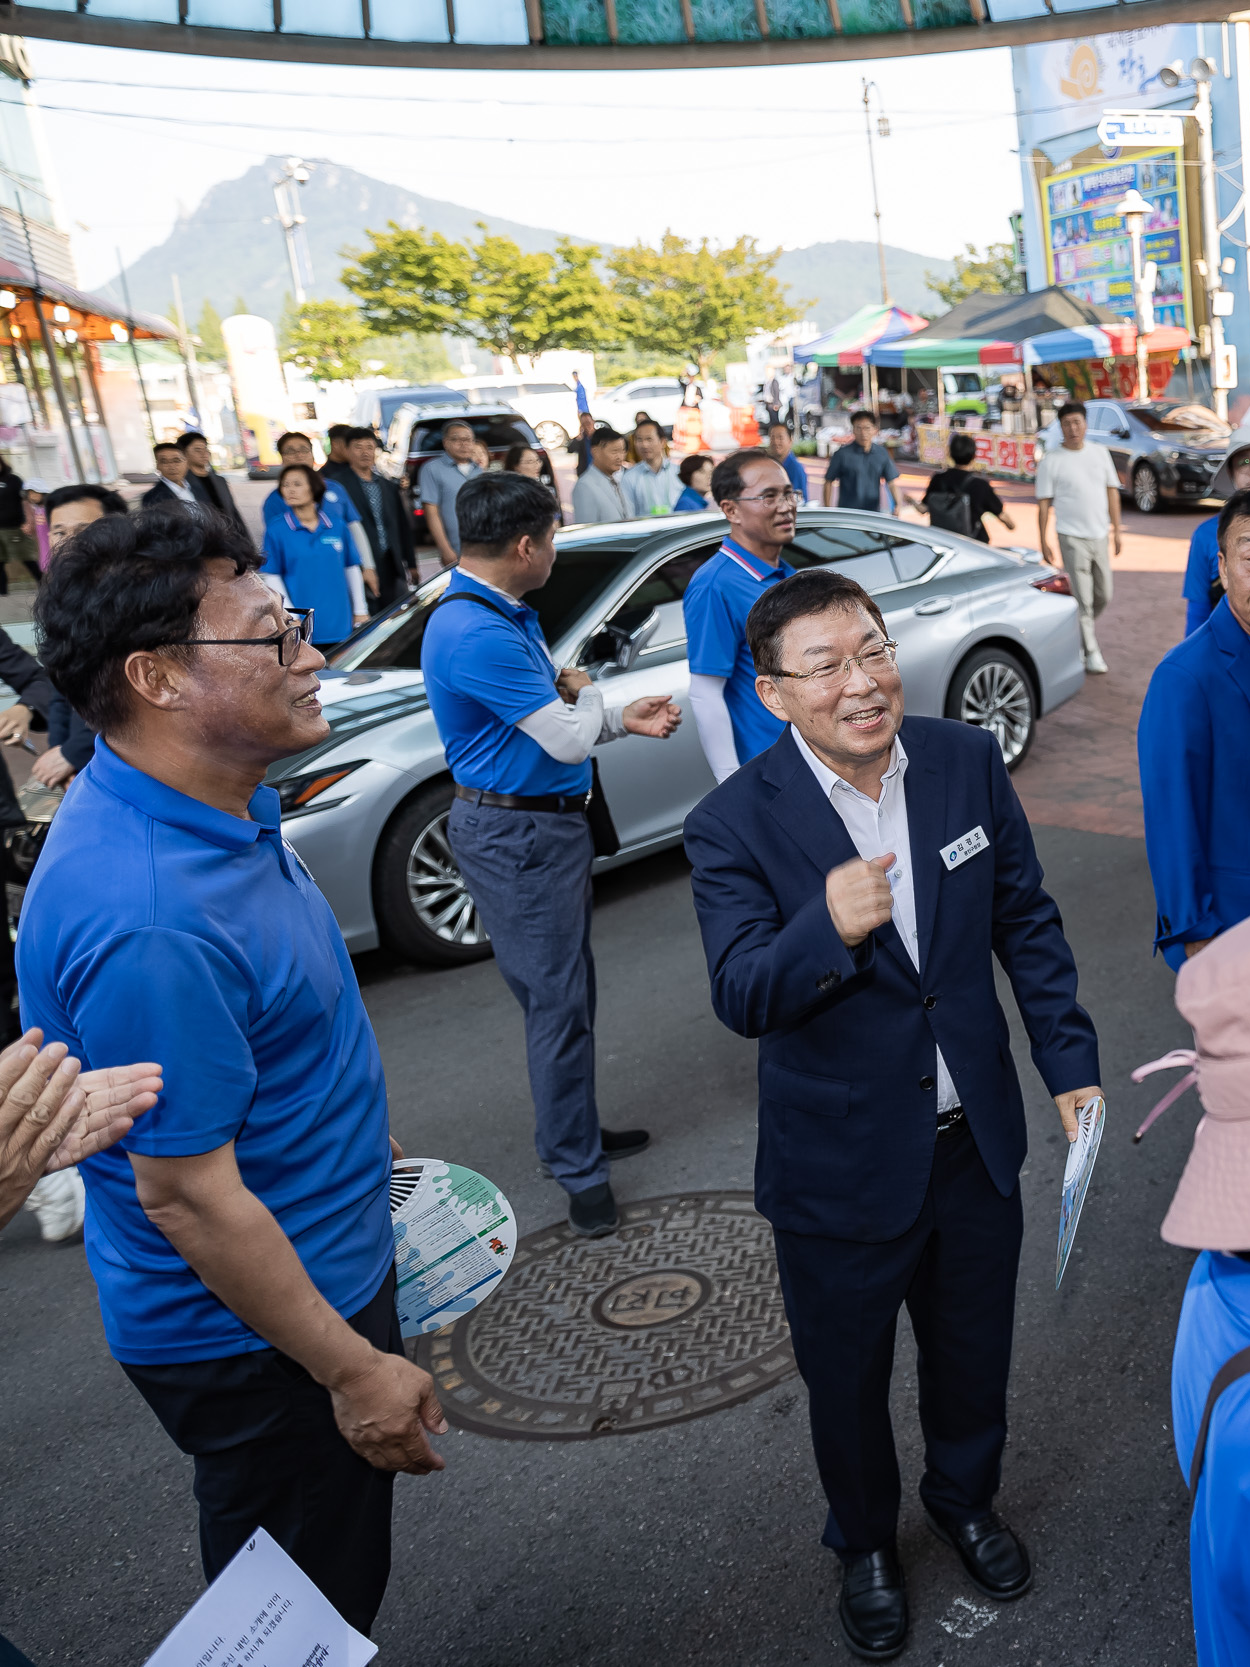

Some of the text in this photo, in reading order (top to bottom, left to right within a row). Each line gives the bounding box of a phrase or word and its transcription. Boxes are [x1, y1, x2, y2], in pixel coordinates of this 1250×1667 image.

[234, 1634, 250, 1652] 내빈
[249, 1609, 269, 1635] 소개에
[266, 1592, 282, 1609] 이어
[244, 1599, 294, 1662] 하시게 되겠습니다.
